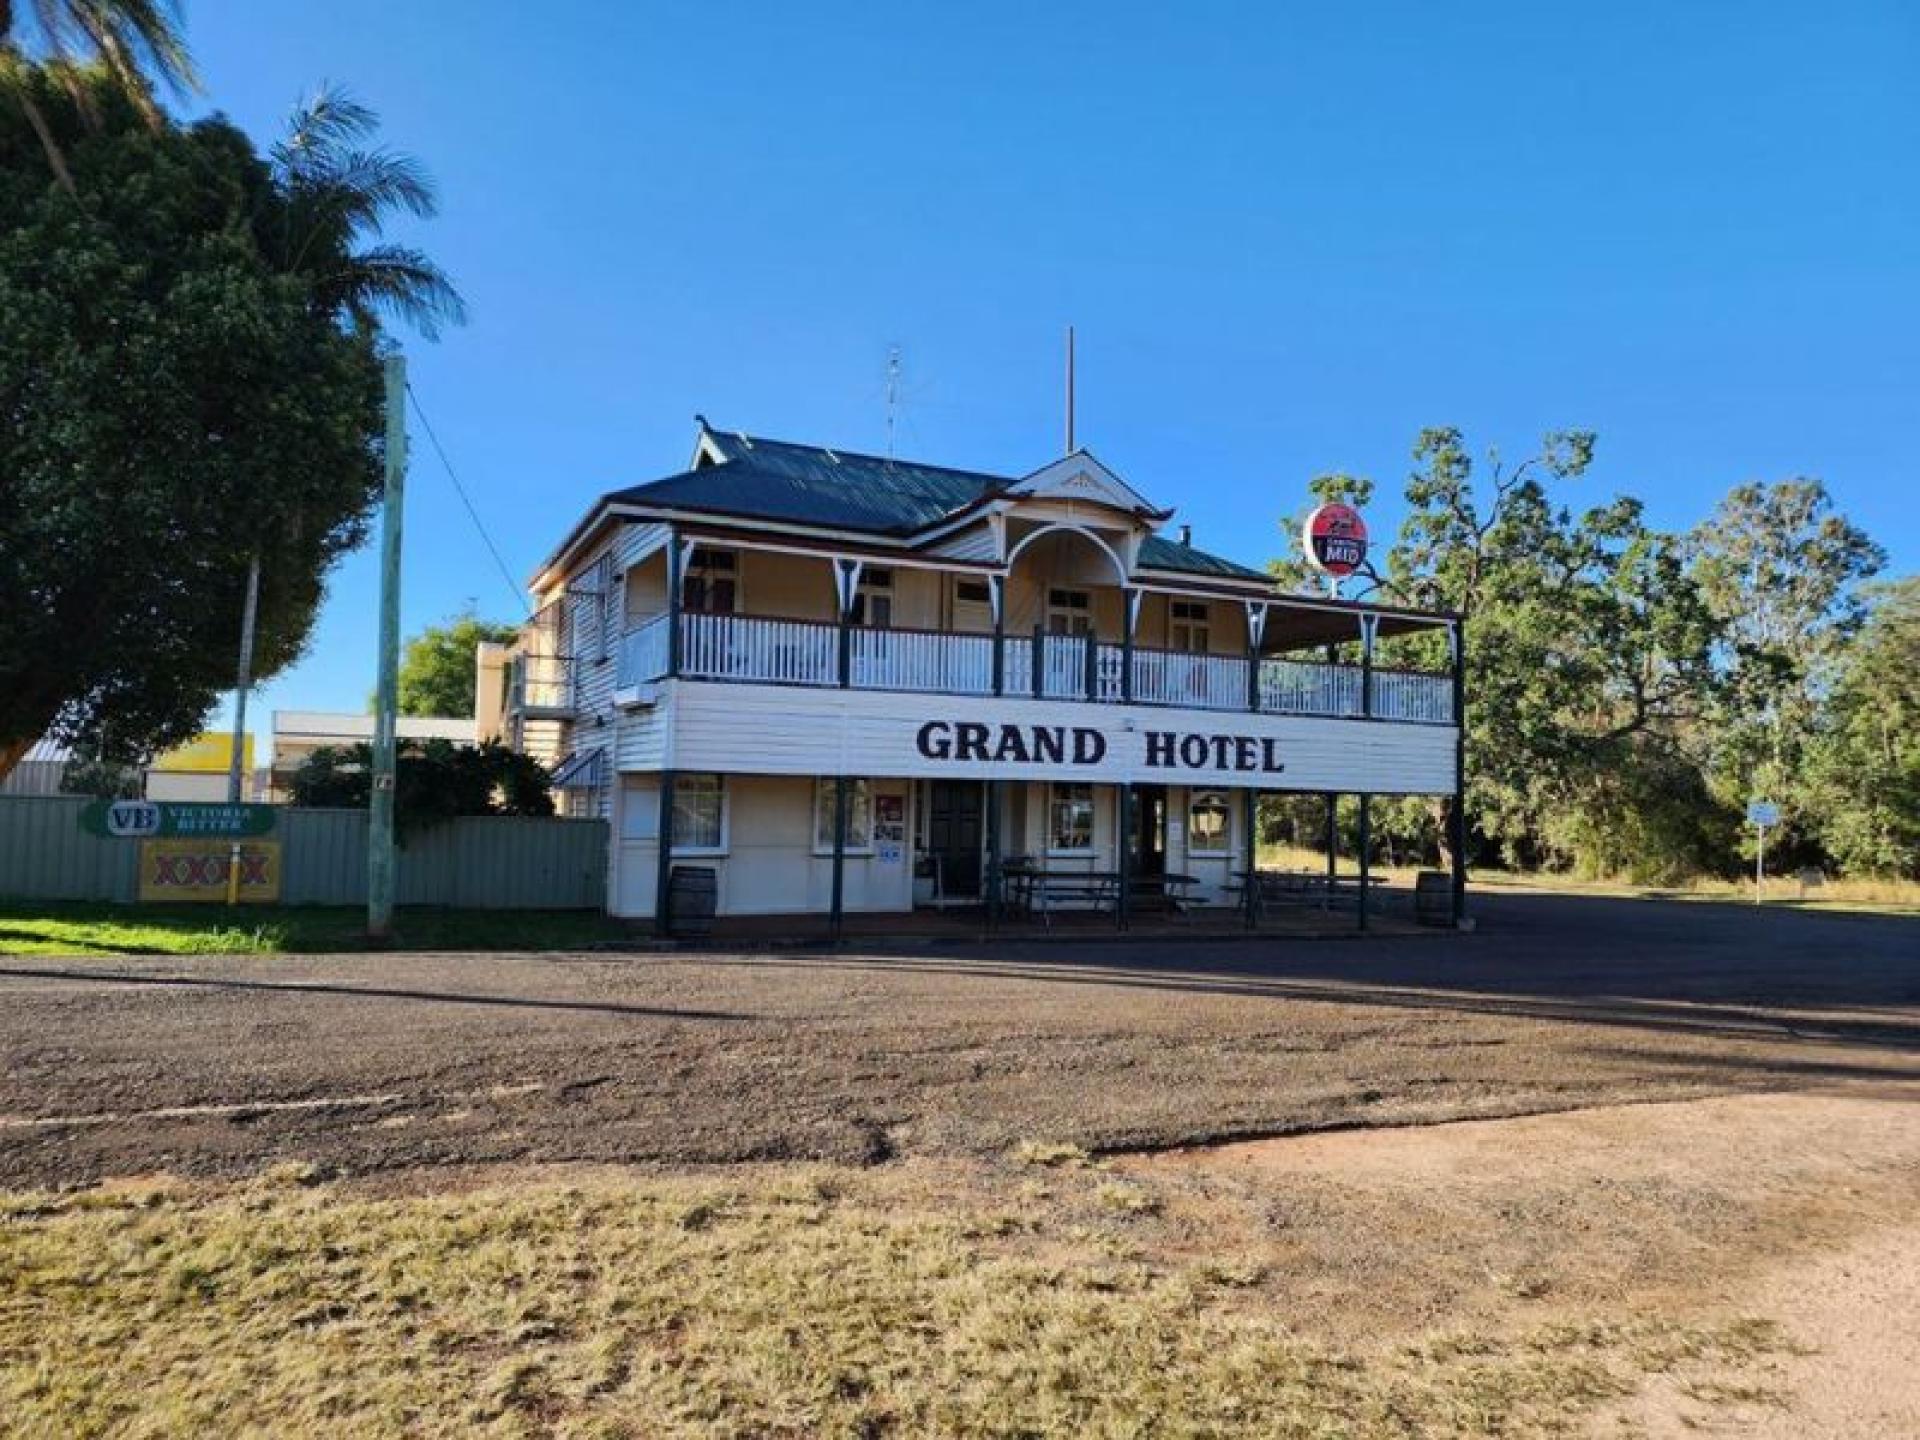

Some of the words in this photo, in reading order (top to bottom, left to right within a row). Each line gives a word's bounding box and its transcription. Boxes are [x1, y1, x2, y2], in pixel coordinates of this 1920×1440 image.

[916, 720, 1107, 764] GRAND
[1145, 731, 1284, 773] HOTEL
[112, 808, 157, 829] VB
